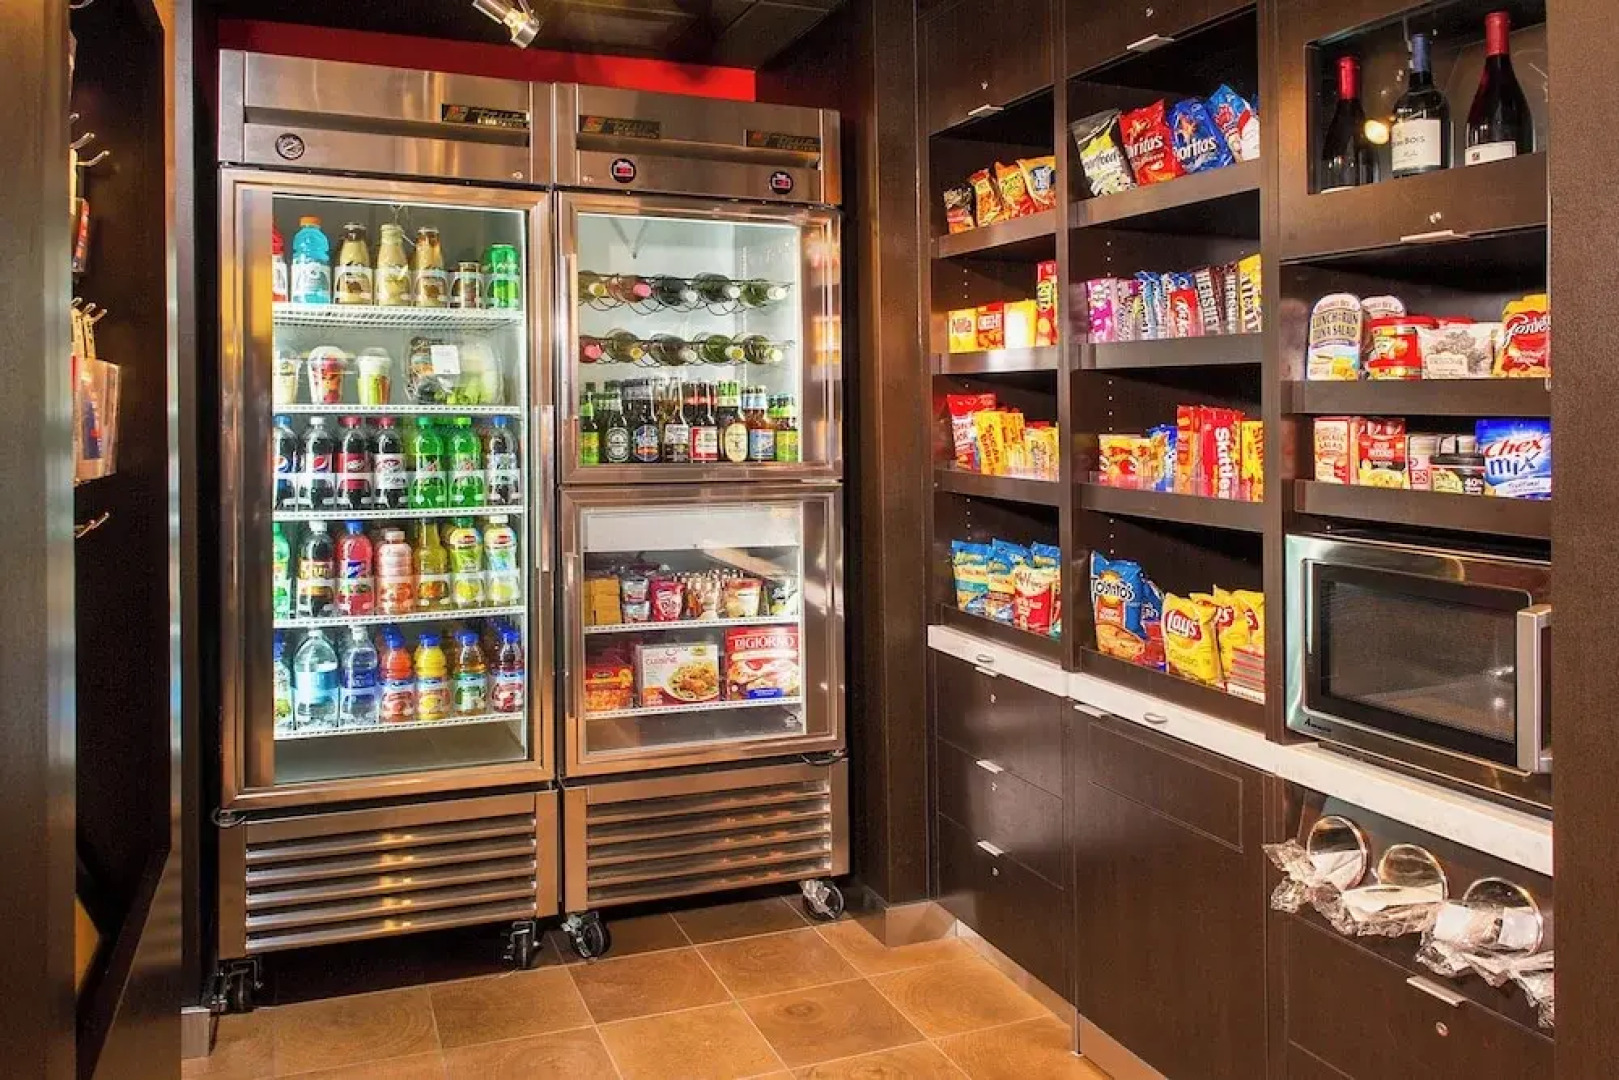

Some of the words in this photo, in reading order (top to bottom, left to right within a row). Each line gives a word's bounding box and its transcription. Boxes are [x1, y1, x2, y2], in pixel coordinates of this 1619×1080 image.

[1125, 134, 1164, 158] oritos
[1484, 437, 1543, 458] Chex
[1214, 427, 1234, 500] Skittles
